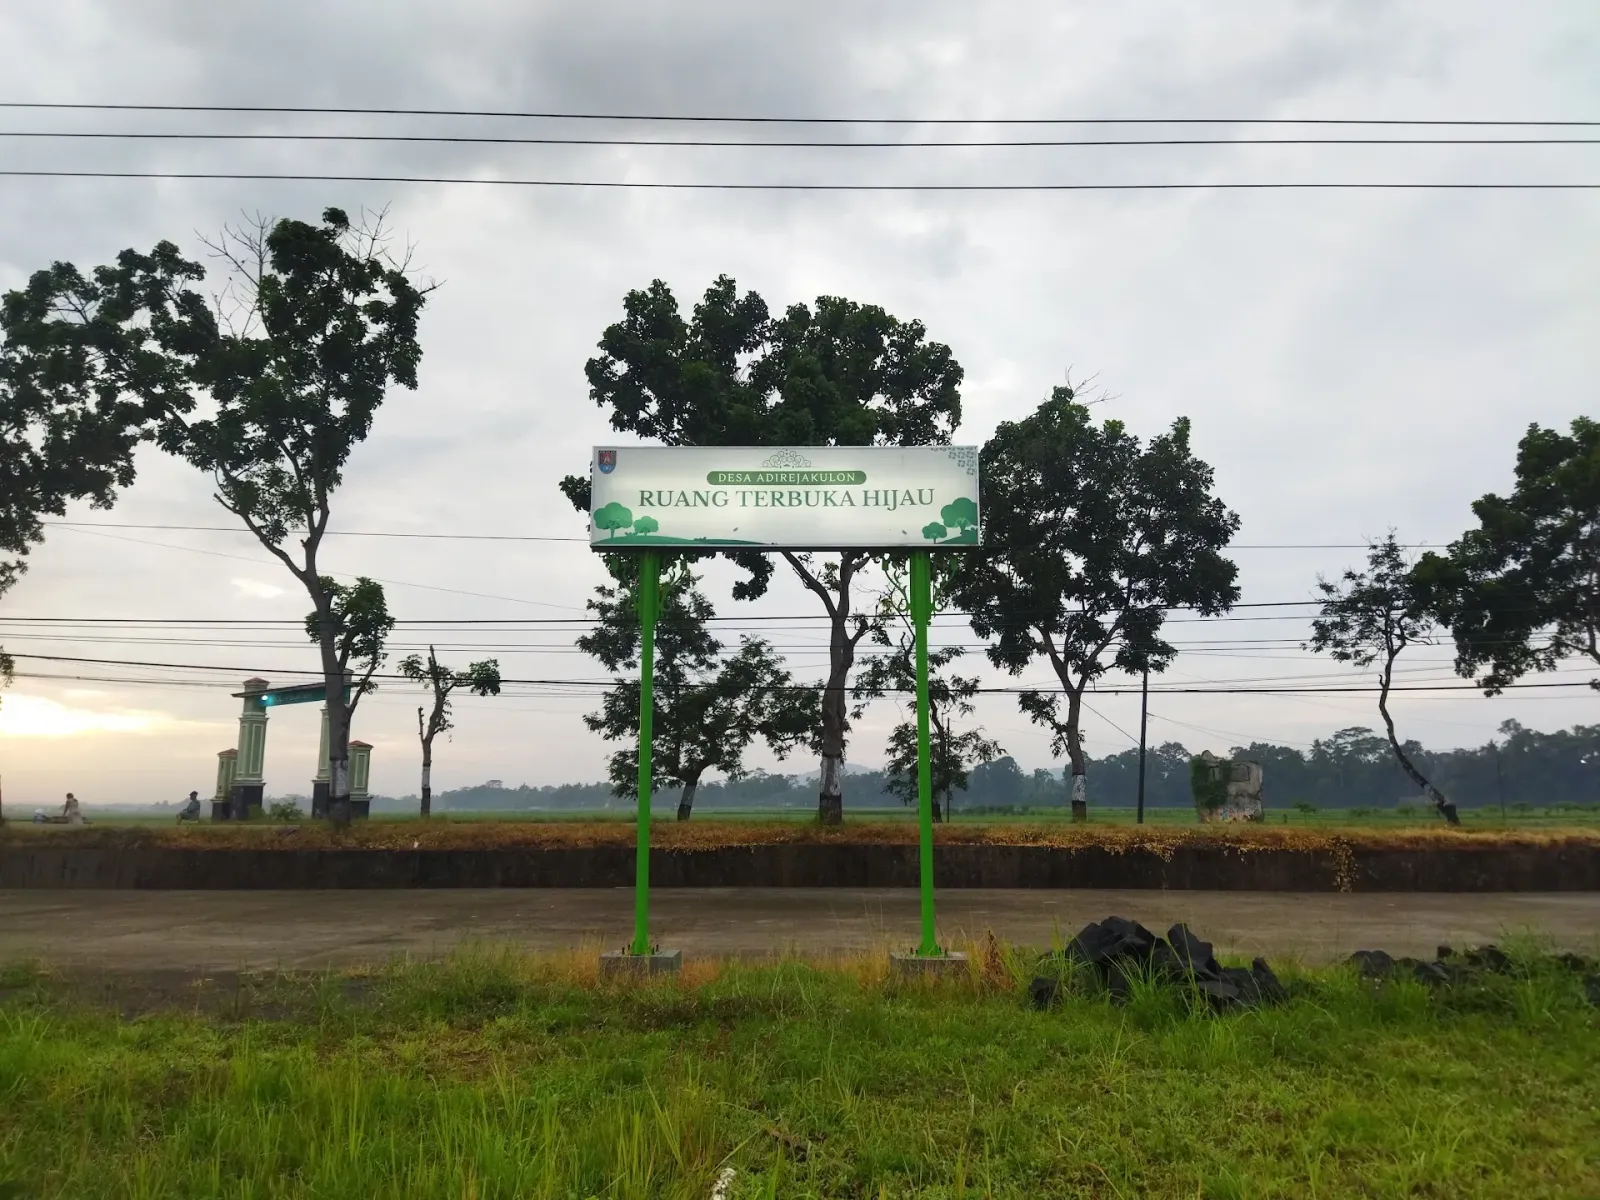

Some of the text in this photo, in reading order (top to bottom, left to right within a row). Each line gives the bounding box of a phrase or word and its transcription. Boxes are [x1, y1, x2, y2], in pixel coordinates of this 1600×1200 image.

[718, 473, 855, 484] DESA ADIREJAKULON
[639, 489, 935, 511] RUANG TERBUKA HIJAU
